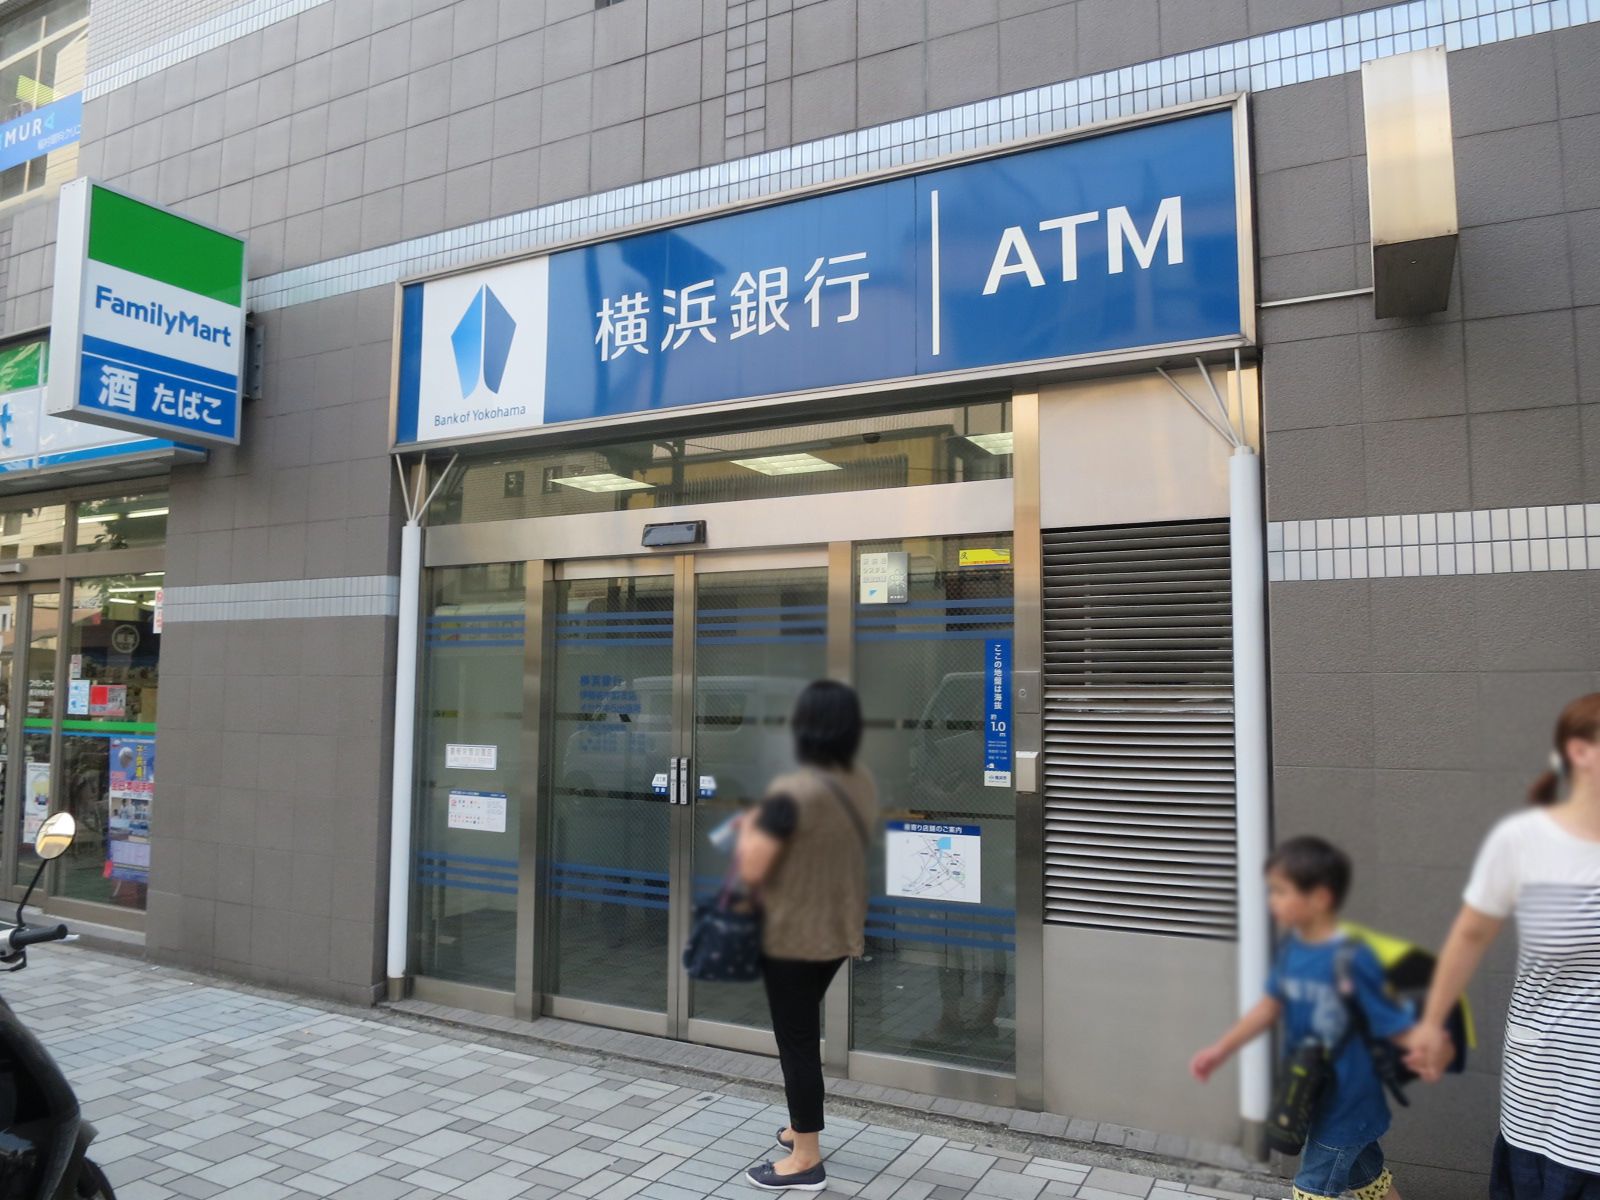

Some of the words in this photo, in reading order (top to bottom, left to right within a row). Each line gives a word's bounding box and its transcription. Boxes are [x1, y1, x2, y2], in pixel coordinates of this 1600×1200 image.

[982, 196, 1184, 296] ATM
[95, 284, 231, 348] FamilyMart
[595, 251, 870, 362] 横浜銀行
[98, 364, 139, 412] 酒
[151, 382, 222, 425] たばこ
[434, 413, 461, 427] Bank
[459, 411, 471, 424] of
[472, 405, 526, 421] Yokohama
[991, 721, 1007, 732] 1.0
